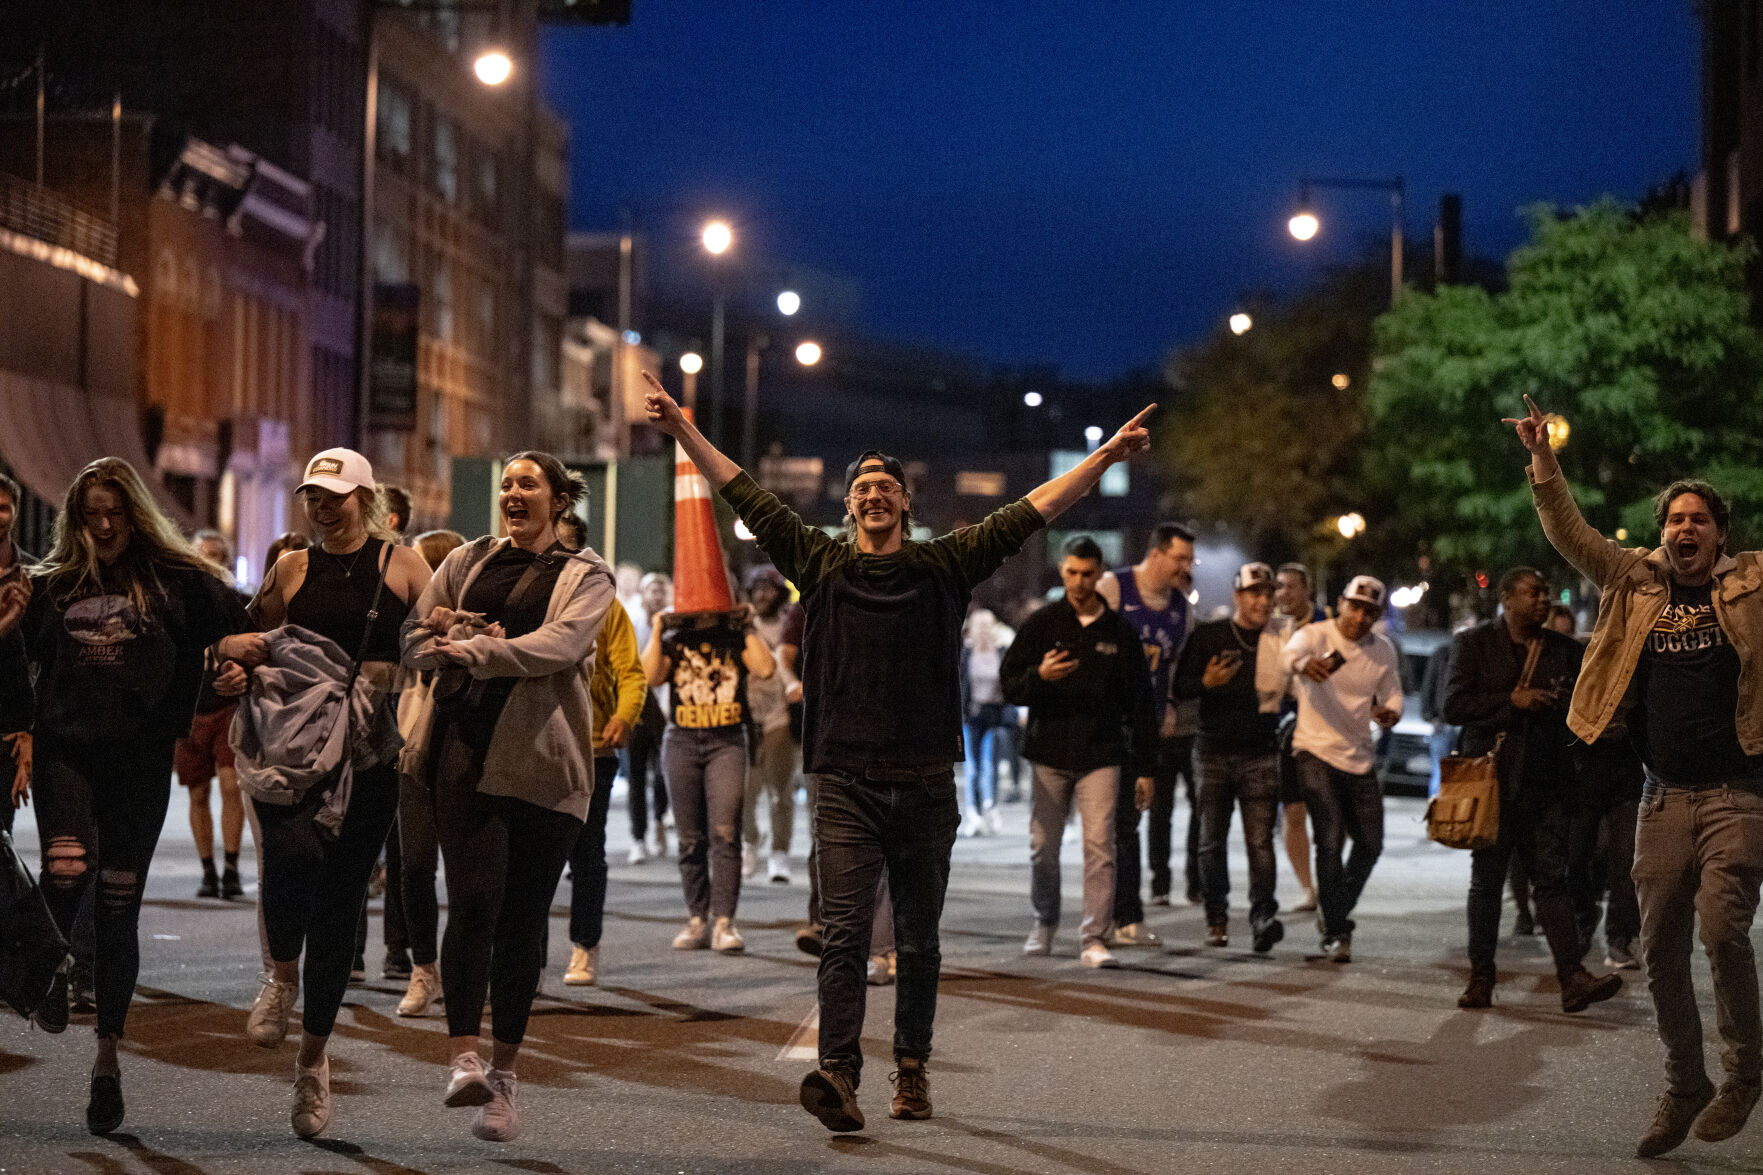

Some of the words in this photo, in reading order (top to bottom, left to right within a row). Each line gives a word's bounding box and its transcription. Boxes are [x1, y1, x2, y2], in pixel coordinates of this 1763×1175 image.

[79, 645, 124, 656] AMBER
[1646, 626, 1723, 653] UGGET
[676, 701, 741, 728] DENVER
